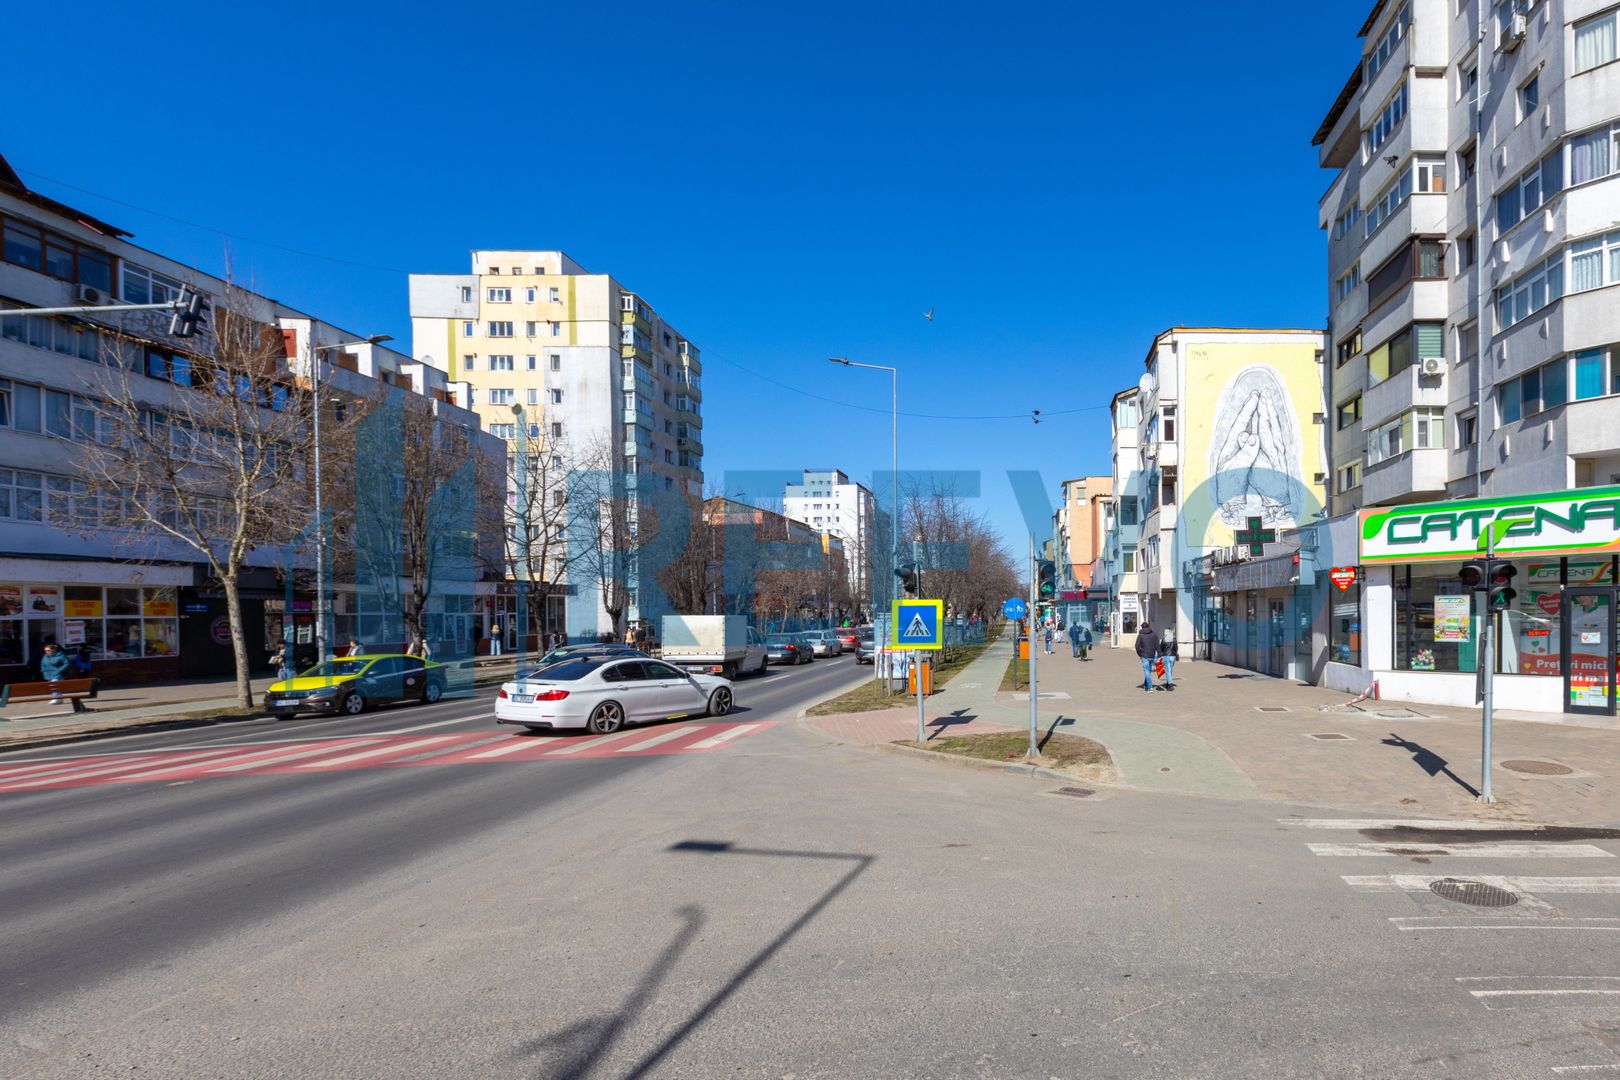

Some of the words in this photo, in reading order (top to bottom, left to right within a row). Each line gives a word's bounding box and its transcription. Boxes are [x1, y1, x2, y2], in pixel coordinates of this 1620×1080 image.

[1387, 499, 1620, 546] CATENA
[1537, 568, 1594, 578] CAENA
[1581, 660, 1608, 669] mici
